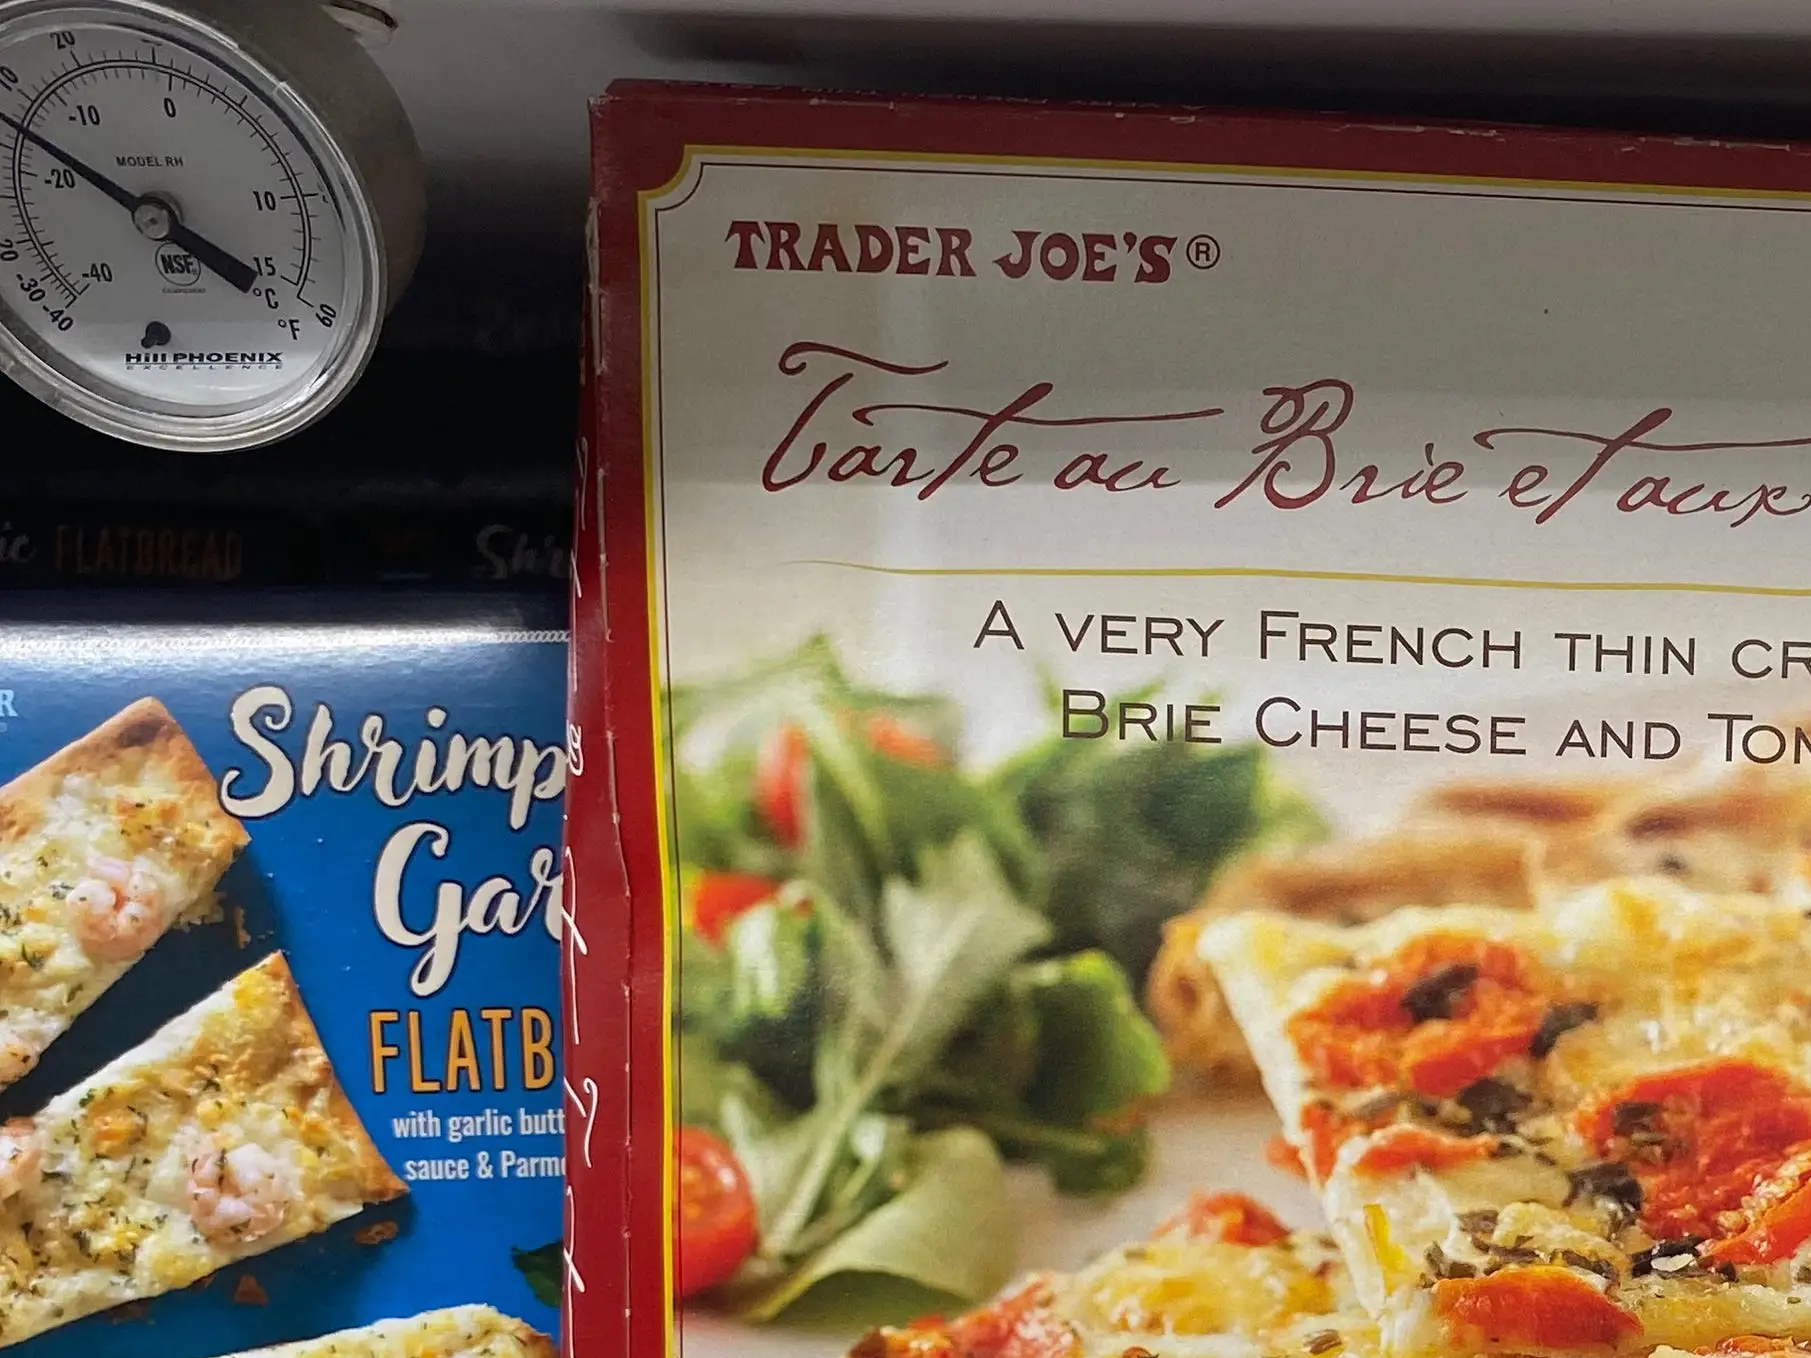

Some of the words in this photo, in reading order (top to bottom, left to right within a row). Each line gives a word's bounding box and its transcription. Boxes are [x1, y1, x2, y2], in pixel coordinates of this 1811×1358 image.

[68, 105, 100, 126] -10
[163, 97, 177, 118] 0
[116, 157, 162, 167] MODEL
[165, 157, 183, 167] RH
[44, 169, 76, 188] -20
[252, 191, 277, 211] 10
[724, 219, 977, 278] TRADER
[82, 262, 113, 283] -40
[160, 253, 194, 275] NSF
[172, 352, 284, 363] PHOENIX
[762, 341, 1224, 501] Tarte
[1053, 451, 1182, 492] au
[1214, 378, 1469, 510] Brie
[55, 524, 243, 579] FLATBREAD
[972, 599, 1025, 650] A
[220, 684, 567, 831] Shrimp
[393, 1109, 441, 1138] with
[448, 1108, 512, 1143] garlic
[404, 1157, 470, 1181] sauce
[476, 1151, 493, 1179] &
